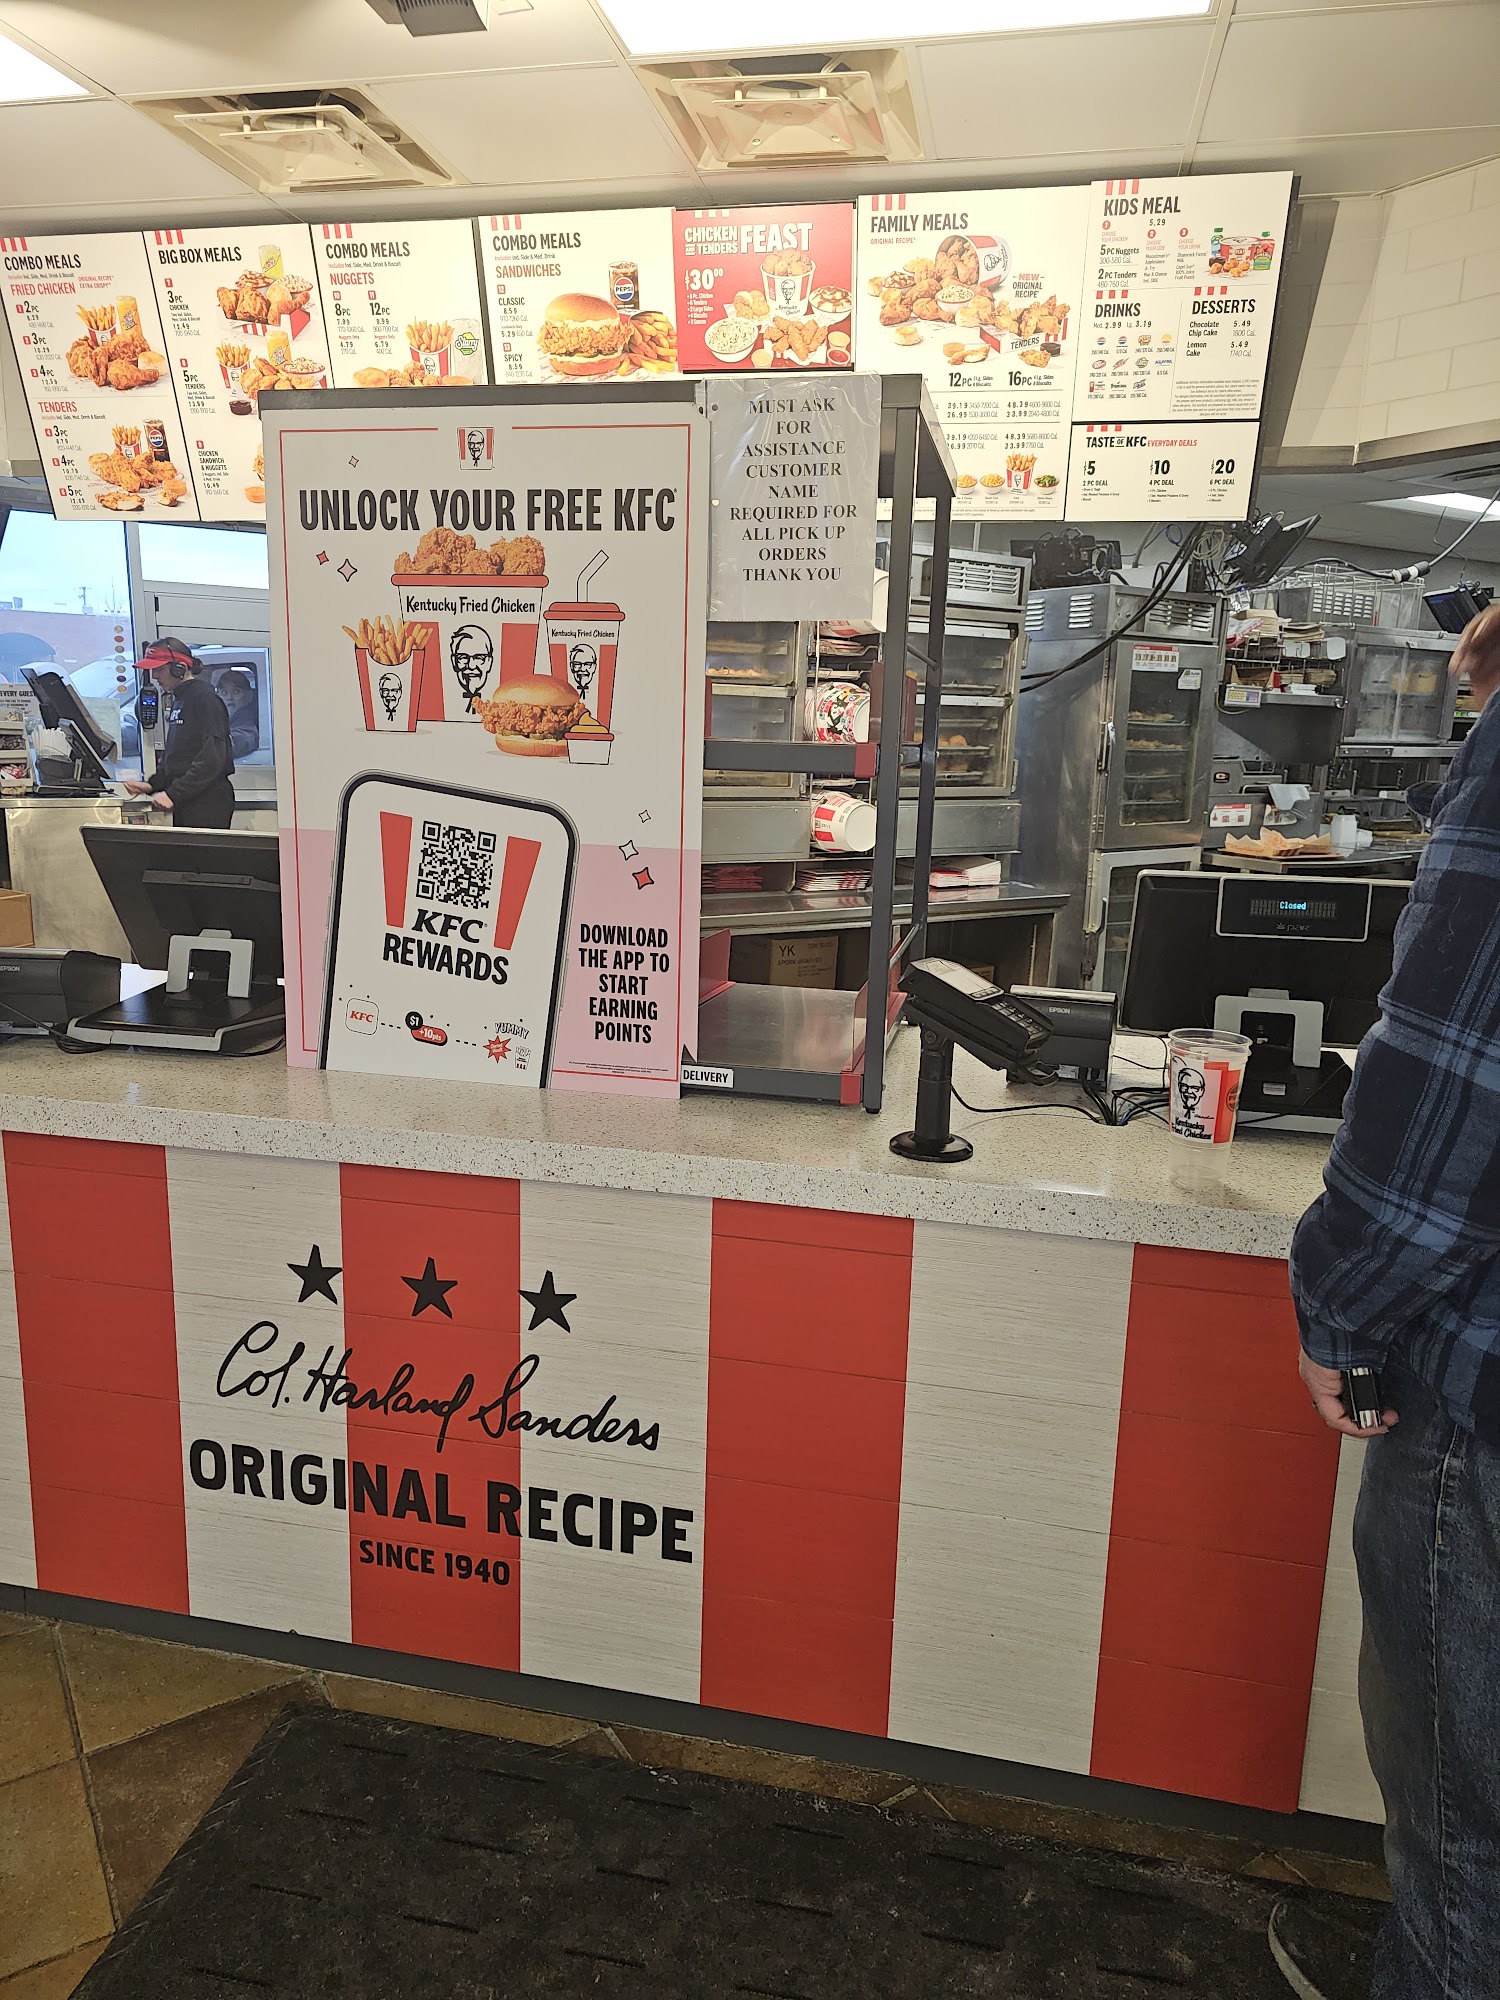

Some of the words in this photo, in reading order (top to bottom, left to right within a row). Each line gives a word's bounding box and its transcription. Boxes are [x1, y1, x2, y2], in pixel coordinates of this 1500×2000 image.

[1103, 198, 1139, 216] KIDS
[1142, 196, 1181, 215] MEAL
[870, 215, 919, 233] FAMILY
[923, 213, 969, 231] MEALS
[1149, 218, 1166, 227] 5.29
[493, 234, 537, 252] COMBO
[540, 232, 582, 250] MEALS
[684, 225, 738, 243] CHICKEN
[740, 222, 813, 253] FEAST
[158, 249, 179, 265] BIG
[179, 248, 203, 263] BOX
[204, 246, 242, 263] MEALS
[325, 243, 368, 259] COMBO
[370, 241, 411, 257] MEALS
[697, 242, 738, 255] TENDERS
[1115, 247, 1140, 256] Nuggets
[4, 256, 43, 271] COMBO
[44, 253, 82, 270] MEALS
[329, 272, 375, 285] NUGGETS
[496, 263, 561, 279] SANDWICHES
[1018, 273, 1040, 281] NEW
[1114, 271, 1137, 279] Tenders
[10, 283, 36, 296] FRIED
[37, 282, 77, 295] CHICKEN
[1012, 282, 1043, 290] ORIGINAL
[498, 297, 525, 306] CLASSIC
[1192, 299, 1256, 315] DESSERTS
[1095, 303, 1141, 318] DRINKS
[1010, 337, 1040, 350] TENDERS
[504, 354, 522, 362] SPICY
[38, 401, 78, 413] TENDERS
[749, 399, 797, 414] MUST
[800, 398, 836, 413] ASK
[776, 420, 812, 435] FOR
[742, 441, 846, 458] ASSISTANCE
[1086, 436, 1115, 448] TASTE
[1125, 436, 1147, 447] KFC
[1178, 439, 1198, 447] DEALS
[746, 463, 842, 478] CUSTOMER
[1083, 460, 1096, 476] $5
[1149, 459, 1171, 475] $10
[1210, 458, 1236, 475] $20
[768, 485, 819, 499] NAME
[299, 489, 420, 531] UNLOCK
[430, 489, 516, 531] YOUR
[527, 488, 602, 531] FREE
[614, 488, 677, 532] KFC
[730, 505, 818, 522] REQUIRED
[823, 504, 858, 518] FOR
[742, 527, 775, 541] ALL
[779, 527, 819, 540] PICK
[825, 526, 846, 539] UP
[758, 548, 827, 561] ORDERS
[743, 568, 801, 582] THANK
[807, 568, 842, 581] YOU
[406, 595, 457, 616] Kentucky
[459, 597, 488, 612] Fried
[491, 597, 536, 614] Chicken
[551, 629, 577, 638] Kentucky
[577, 629, 593, 638] Fried
[593, 629, 615, 638] Chicken
[1280, 901, 1307, 910] Closed
[411, 908, 485, 944] KFC
[580, 923, 668, 948] DOWNLOAD
[779, 944, 796, 957] YK
[382, 932, 509, 985] REWARDS
[578, 948, 608, 969] THE
[613, 950, 645, 971] APP
[650, 952, 670, 973] TO
[599, 974, 649, 995] START
[589, 997, 658, 1021] EARNING
[350, 1010, 374, 1024] KFC
[409, 1015, 420, 1027] $1
[494, 1022, 530, 1040] YUMMY
[594, 1021, 652, 1044] POINTS
[683, 1069, 729, 1084] DELIVERY
[215, 1319, 306, 1410] Col.
[303, 1345, 476, 1454] Harland
[468, 1353, 661, 1452] Sanders
[189, 1438, 467, 1529] ORIGINAL
[486, 1480, 695, 1564] RECIPE
[358, 1540, 435, 1576] SINCE
[444, 1551, 511, 1586] 1940
